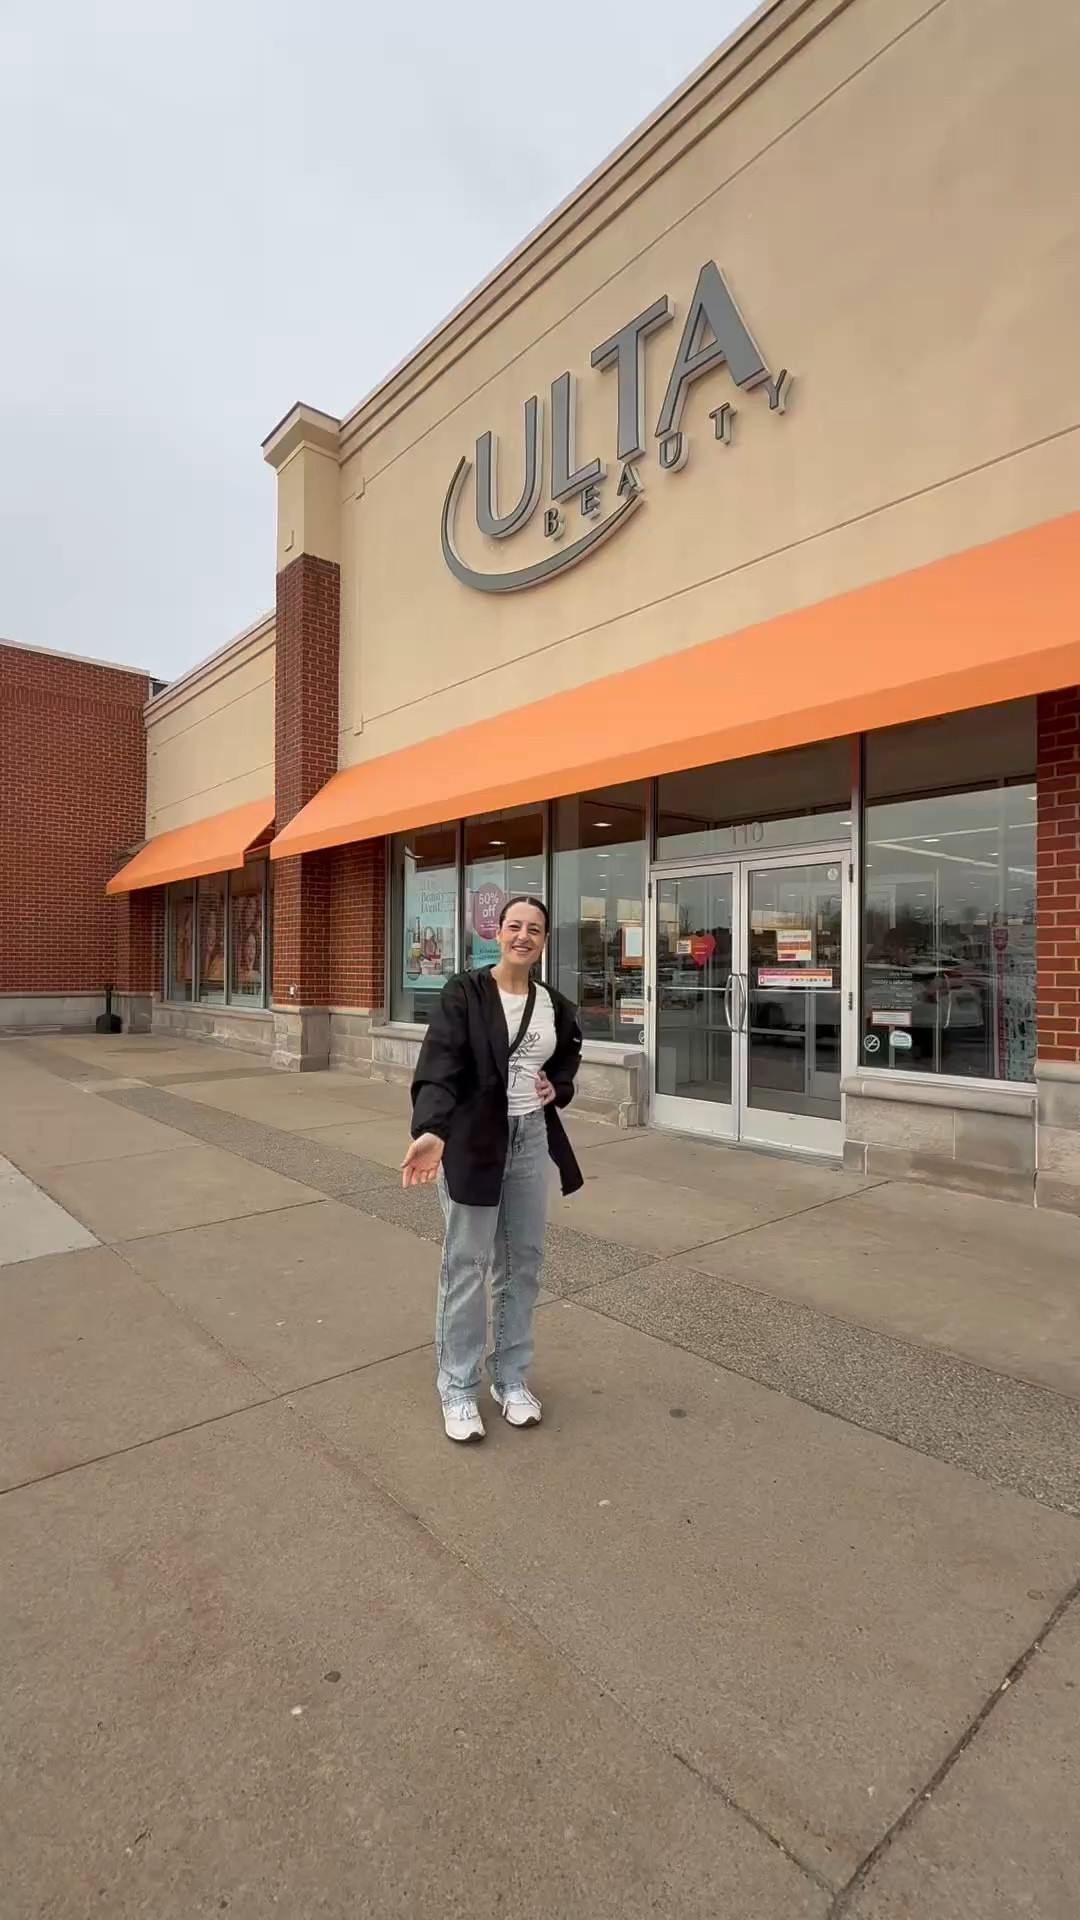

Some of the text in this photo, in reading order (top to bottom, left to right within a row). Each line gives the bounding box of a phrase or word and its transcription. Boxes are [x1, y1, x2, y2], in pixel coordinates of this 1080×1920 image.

[475, 259, 770, 538] ULTA
[544, 369, 793, 540] BEAUTY
[729, 822, 765, 845] 110
[482, 905, 497, 918] off
